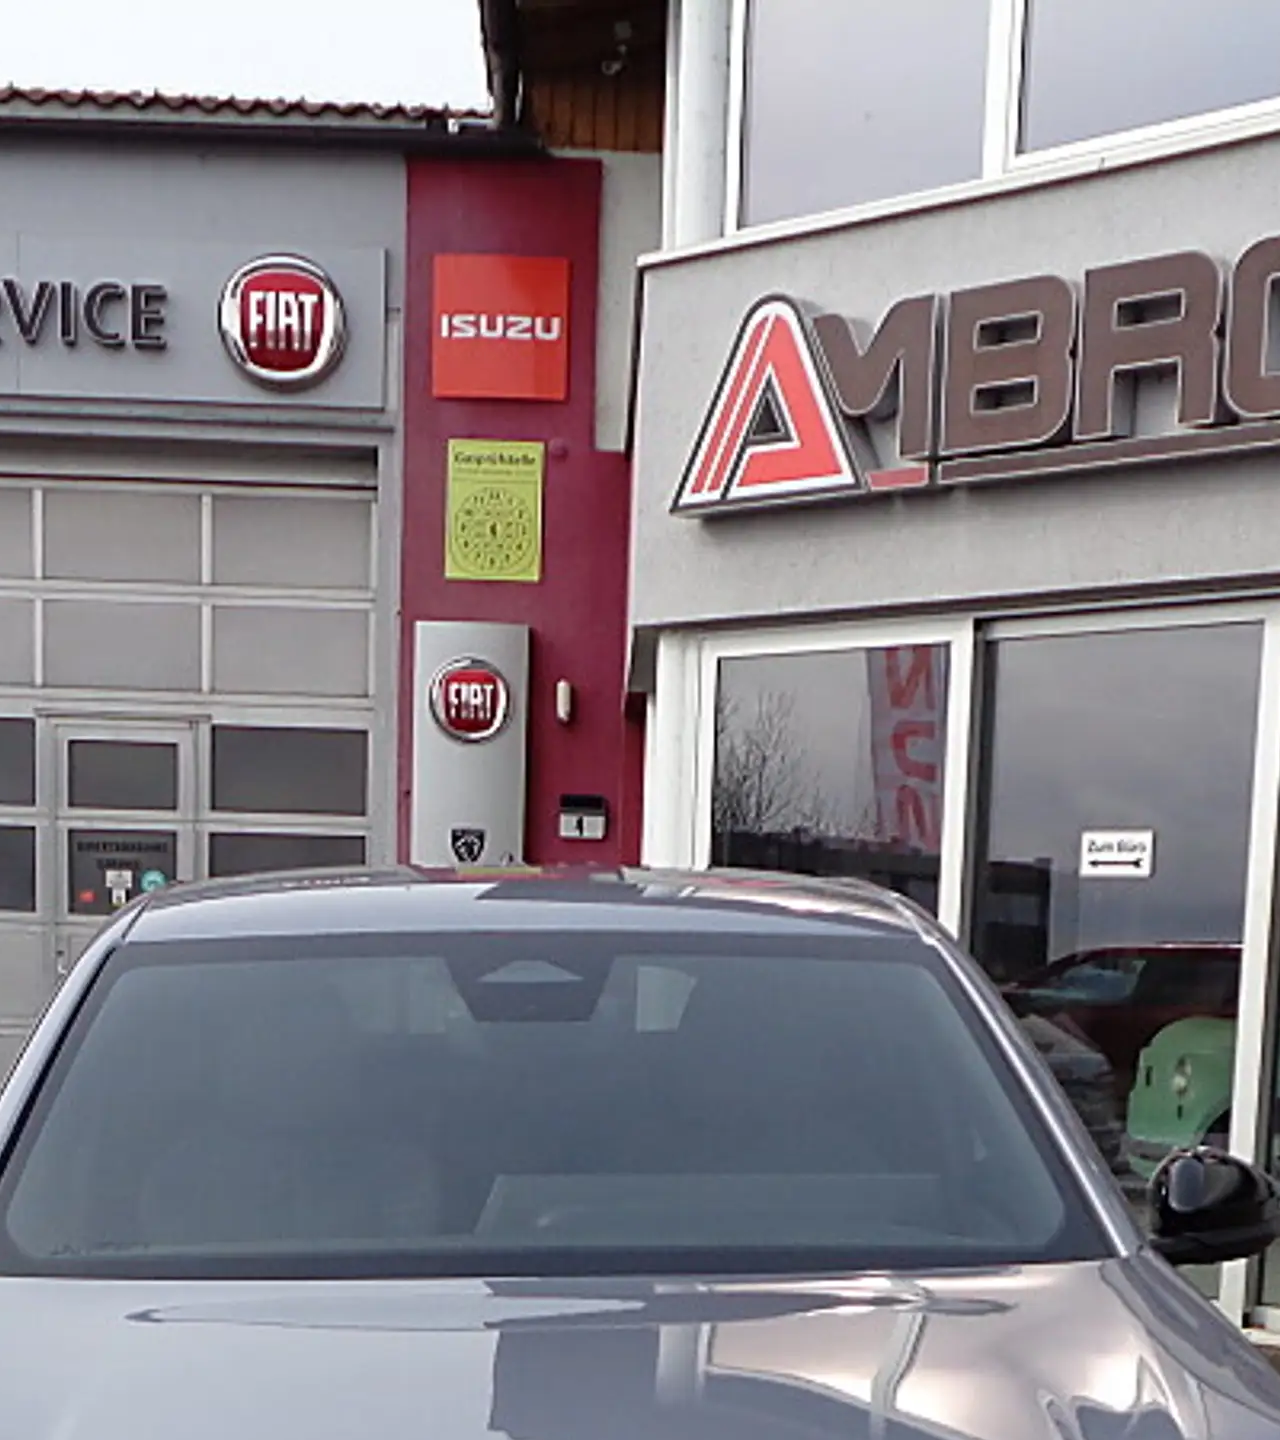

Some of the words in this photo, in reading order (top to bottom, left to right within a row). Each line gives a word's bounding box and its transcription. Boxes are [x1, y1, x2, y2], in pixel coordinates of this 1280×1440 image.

[248, 289, 318, 350] FIAT
[440, 313, 562, 341] ISUZU
[448, 682, 495, 721] FIAT
[1087, 839, 1114, 853] Zum
